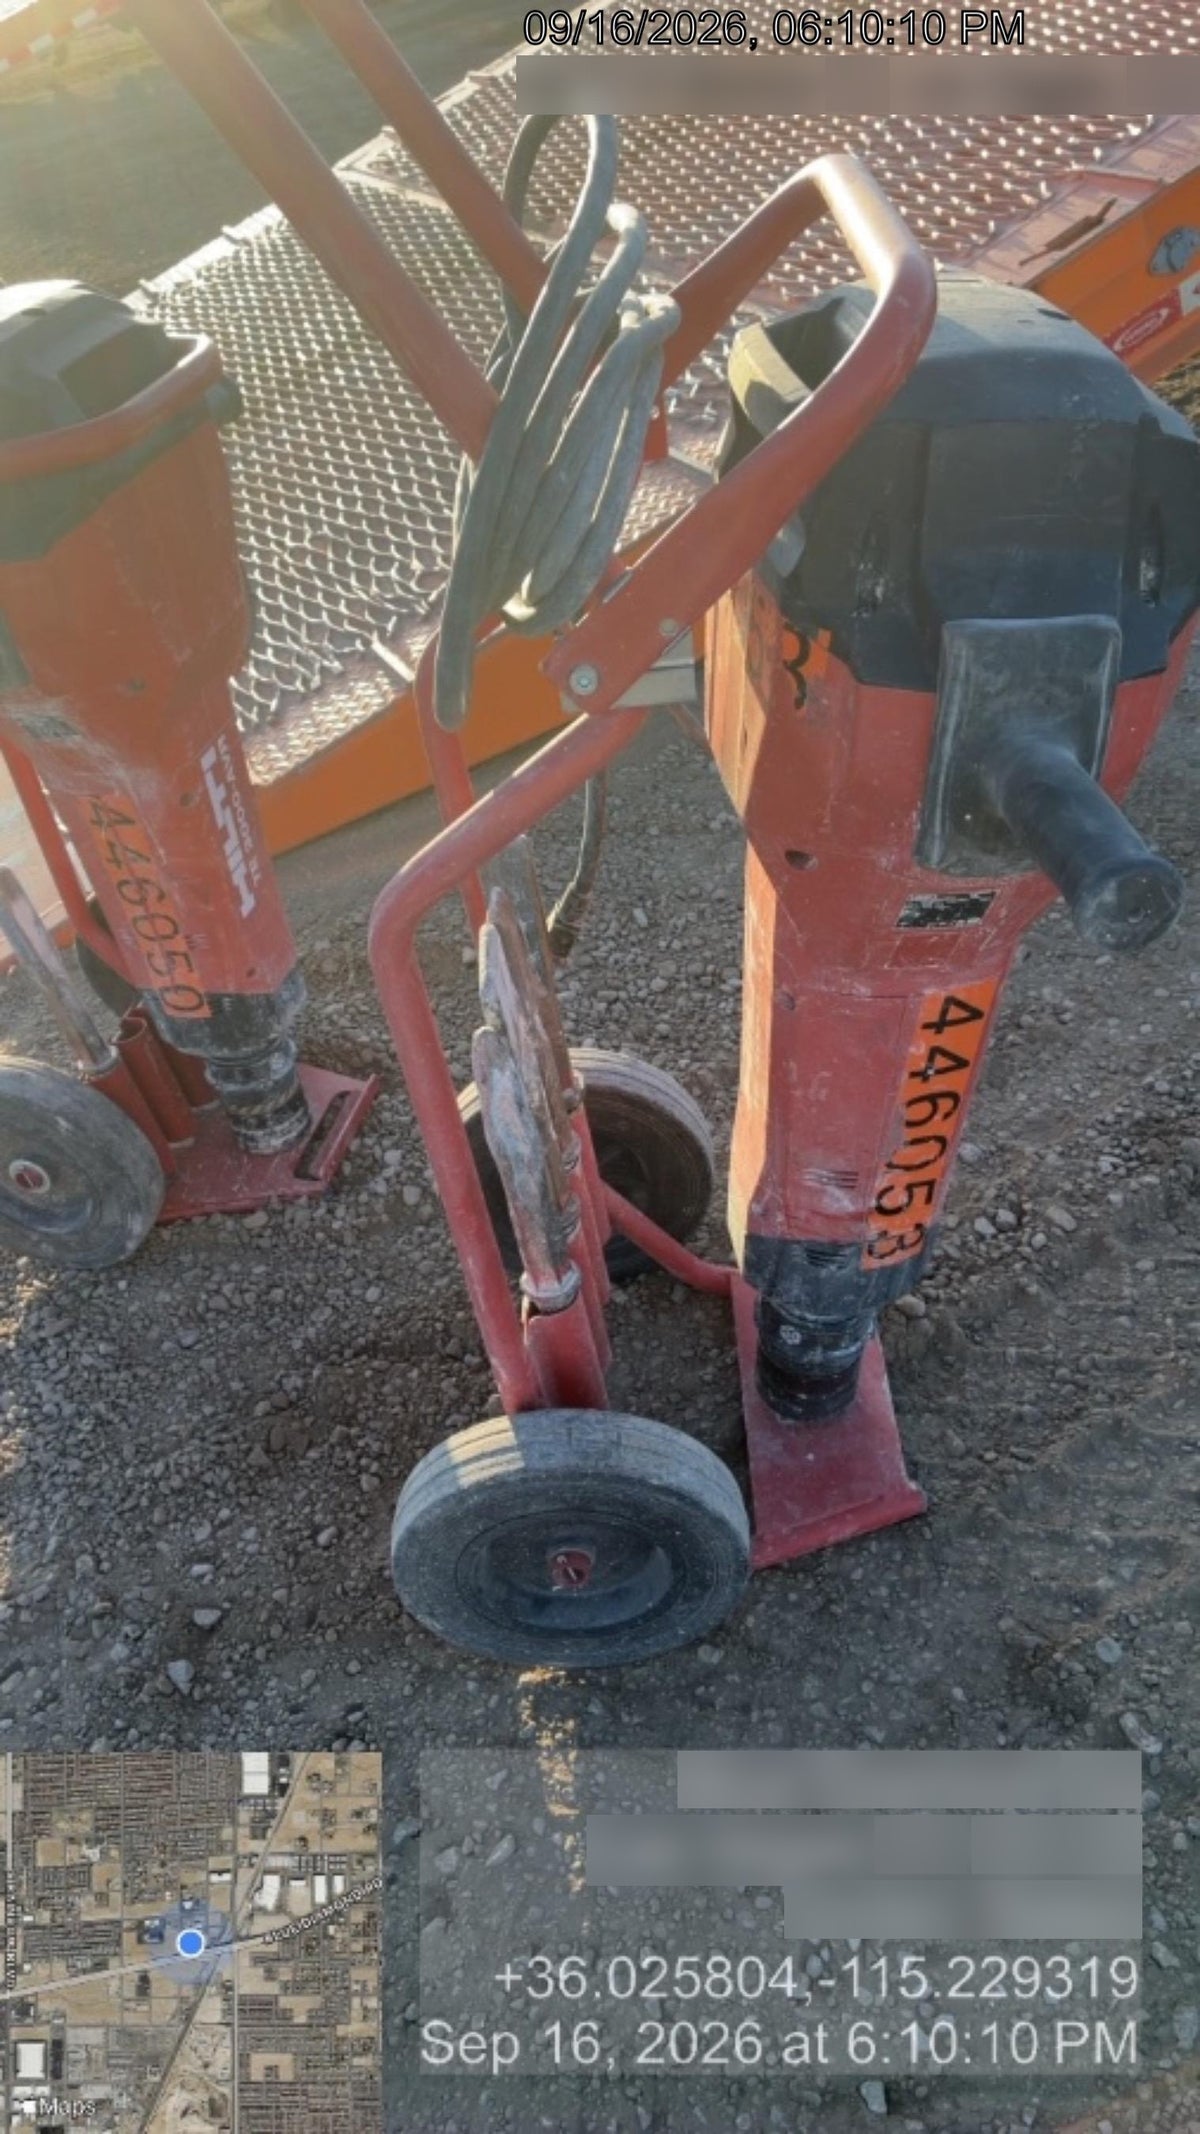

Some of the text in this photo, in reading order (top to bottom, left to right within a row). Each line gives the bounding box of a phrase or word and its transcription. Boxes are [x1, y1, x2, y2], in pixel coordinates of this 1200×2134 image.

[88, 799, 207, 1013] 446050
[201, 746, 257, 918] HILTI
[867, 995, 985, 1260] 446053
